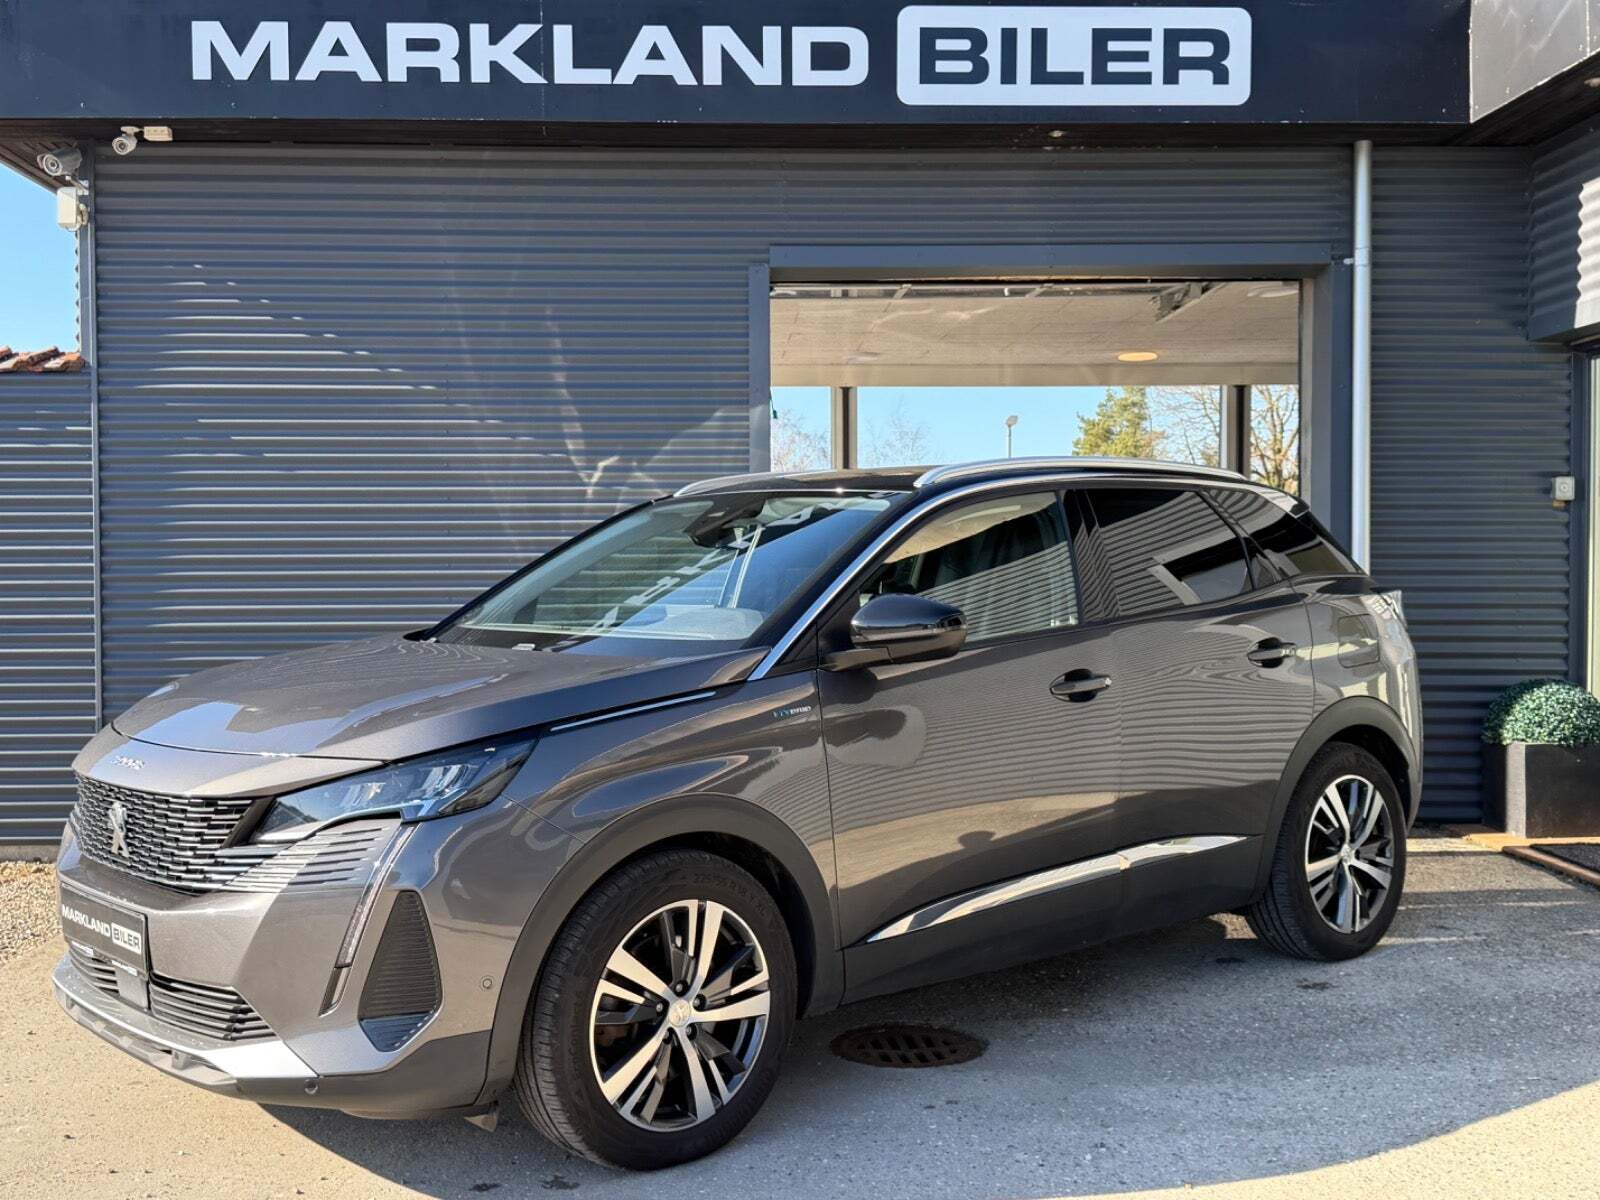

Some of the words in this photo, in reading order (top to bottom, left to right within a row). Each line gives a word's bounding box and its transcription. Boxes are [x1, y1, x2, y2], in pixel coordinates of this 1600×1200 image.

[191, 20, 869, 86] MARKLAND
[919, 27, 1230, 85] BILER
[62, 904, 111, 938] MARKLAND
[113, 926, 141, 951] BILER
